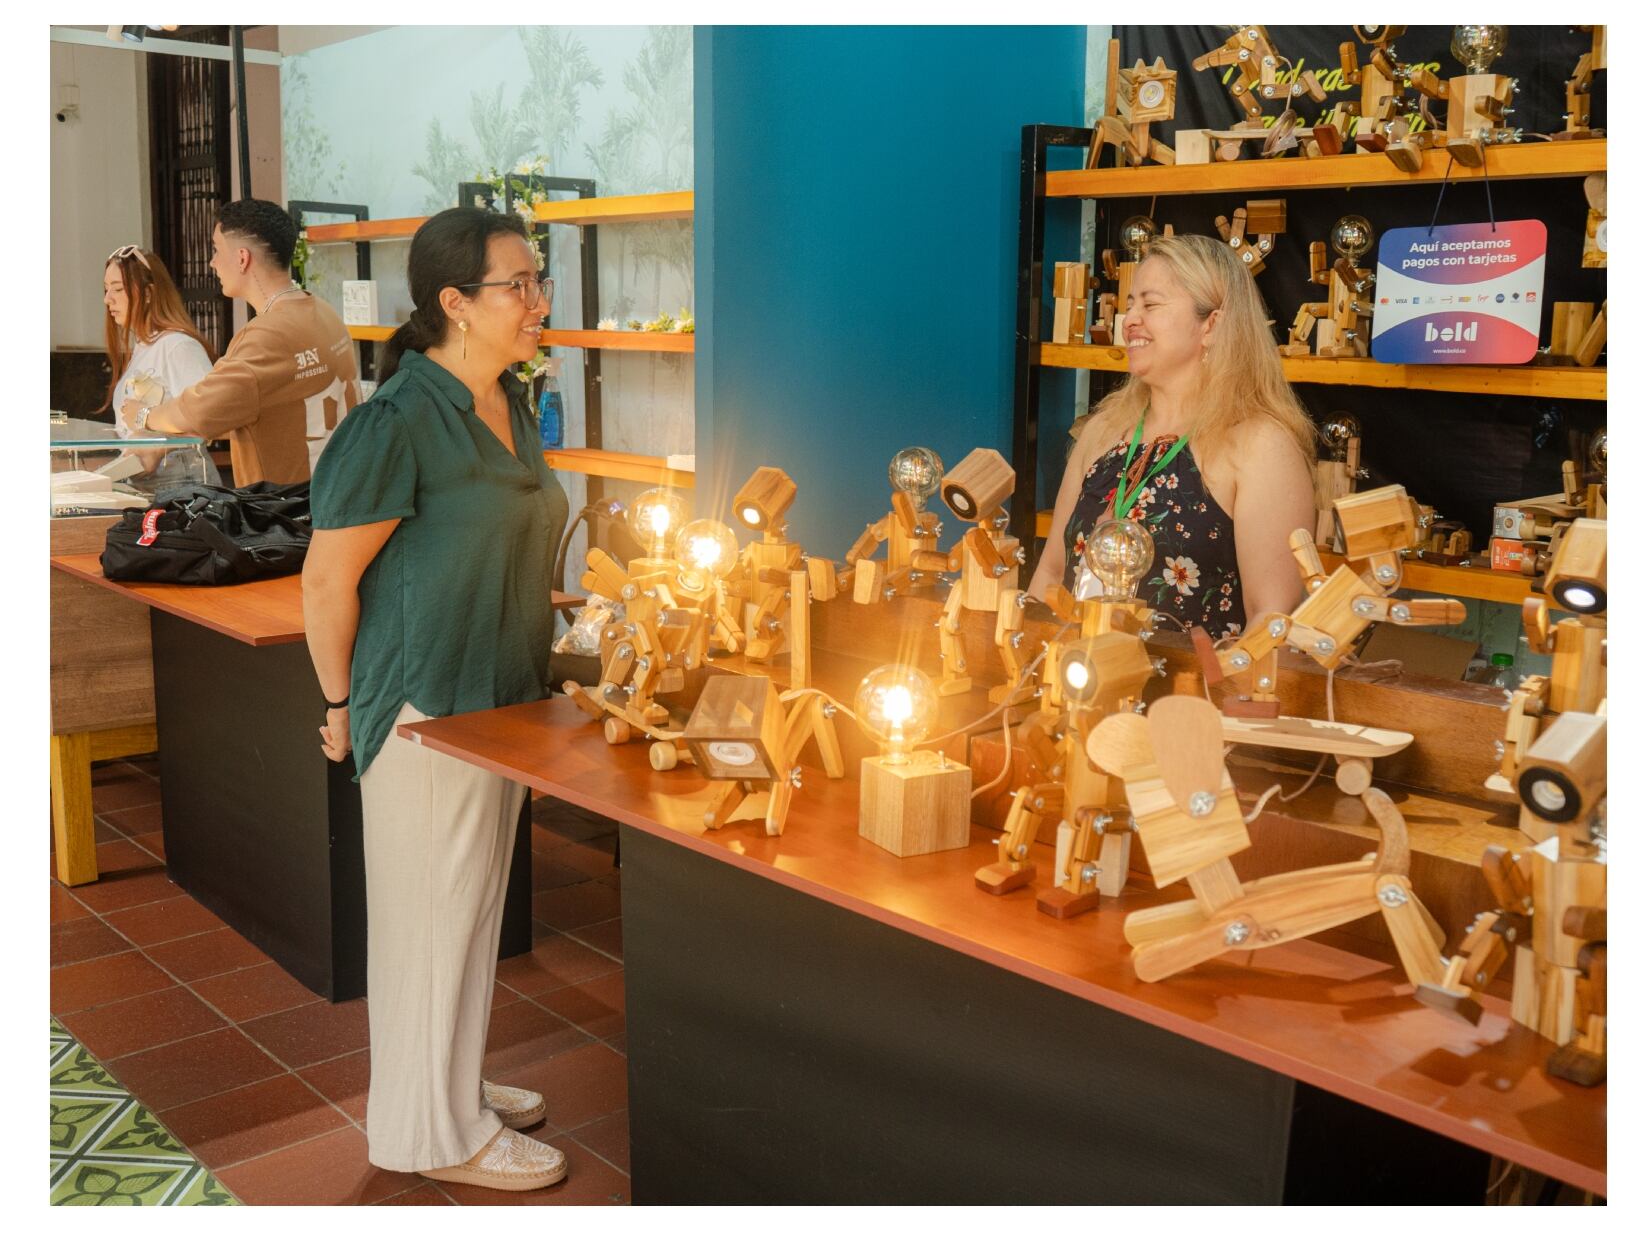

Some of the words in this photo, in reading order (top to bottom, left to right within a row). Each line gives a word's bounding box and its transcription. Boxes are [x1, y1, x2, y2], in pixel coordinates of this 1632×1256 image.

[1409, 241, 1440, 255] Aquí
[1441, 239, 1512, 252] aceptamos
[1402, 257, 1440, 270] pagos
[1442, 256, 1466, 266] con
[1468, 253, 1518, 267] tarjetas
[1424, 321, 1478, 342] bold
[294, 364, 329, 381] IMPOSSIBLE
